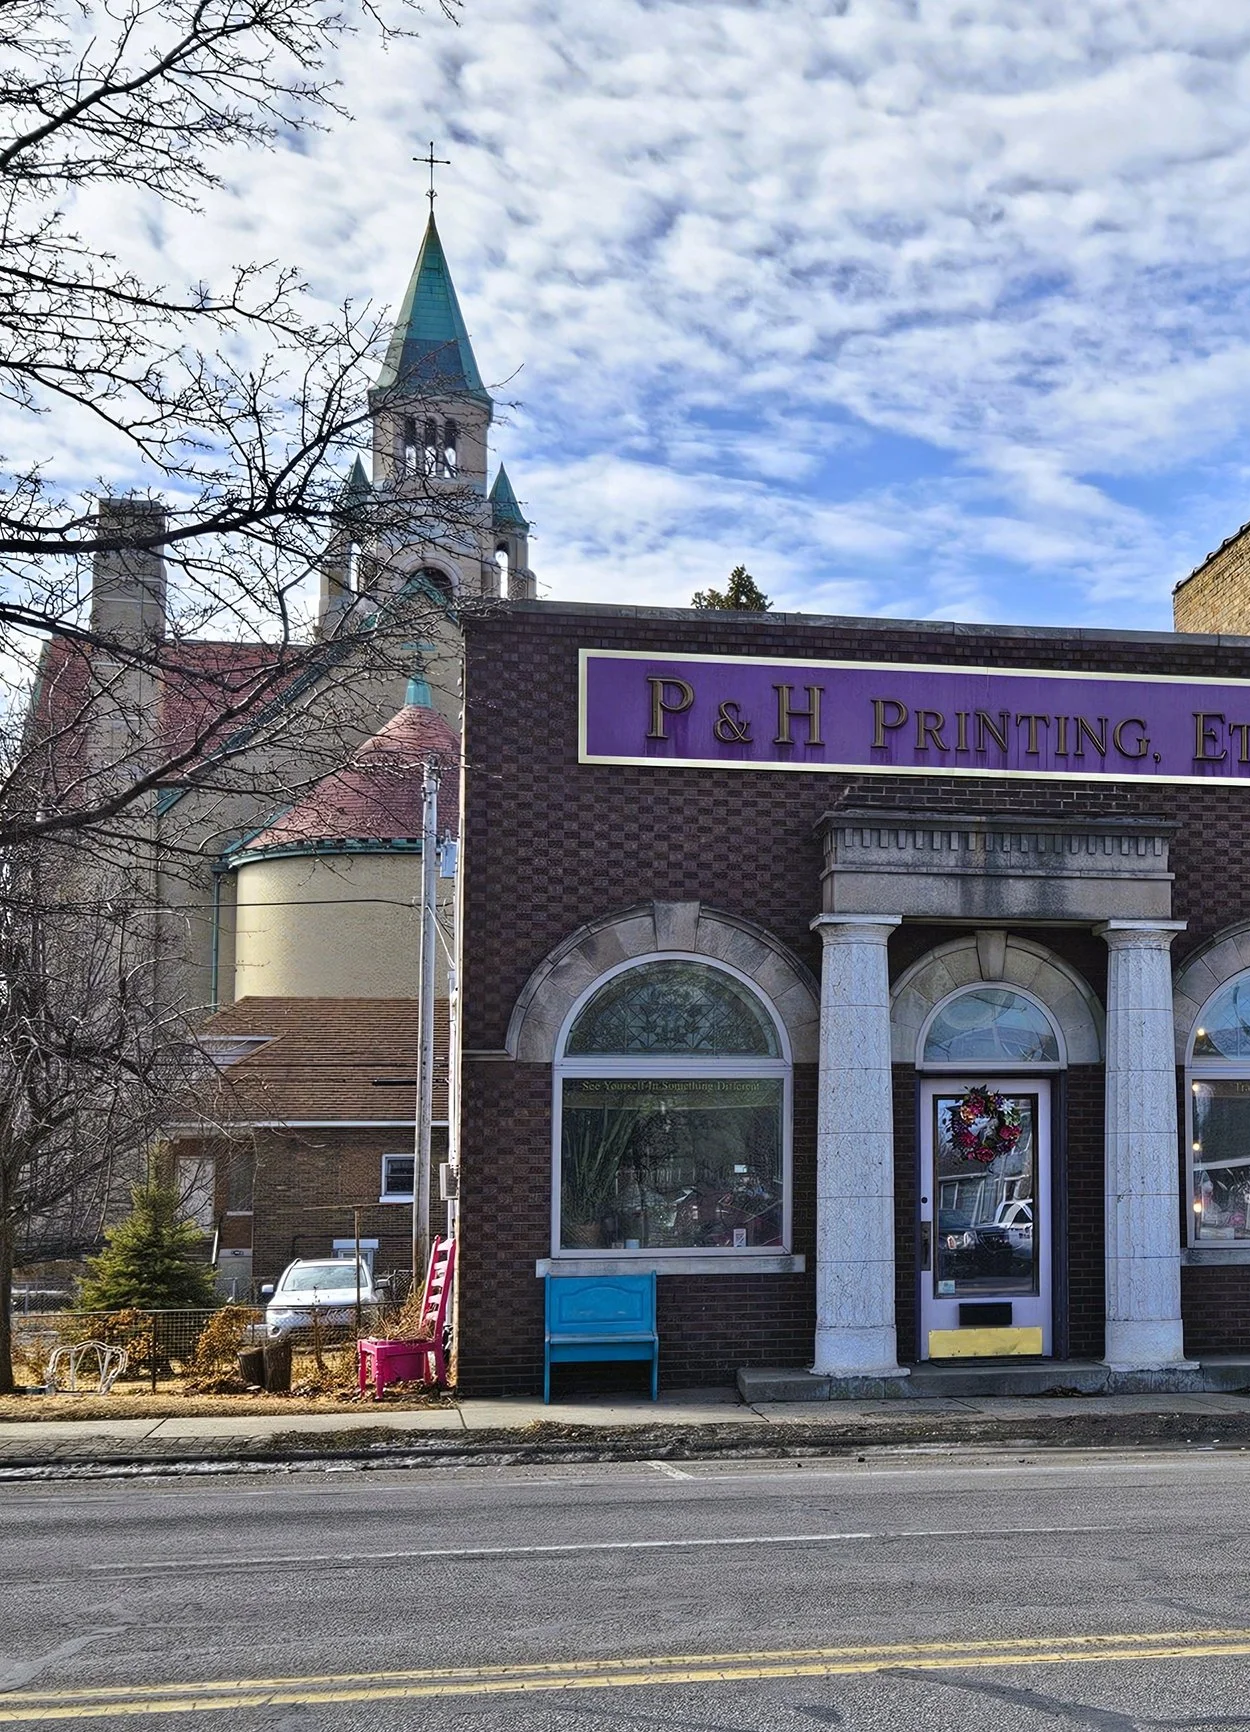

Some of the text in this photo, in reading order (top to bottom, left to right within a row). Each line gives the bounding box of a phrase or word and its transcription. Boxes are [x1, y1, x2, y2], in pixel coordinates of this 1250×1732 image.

[646, 676, 695, 739] P
[713, 700, 753, 744] &
[772, 683, 826, 746] H
[582, 1081, 600, 1091] See
[604, 1081, 647, 1091] Yourself
[662, 1081, 713, 1093] Something
[717, 1081, 760, 1091] Different
